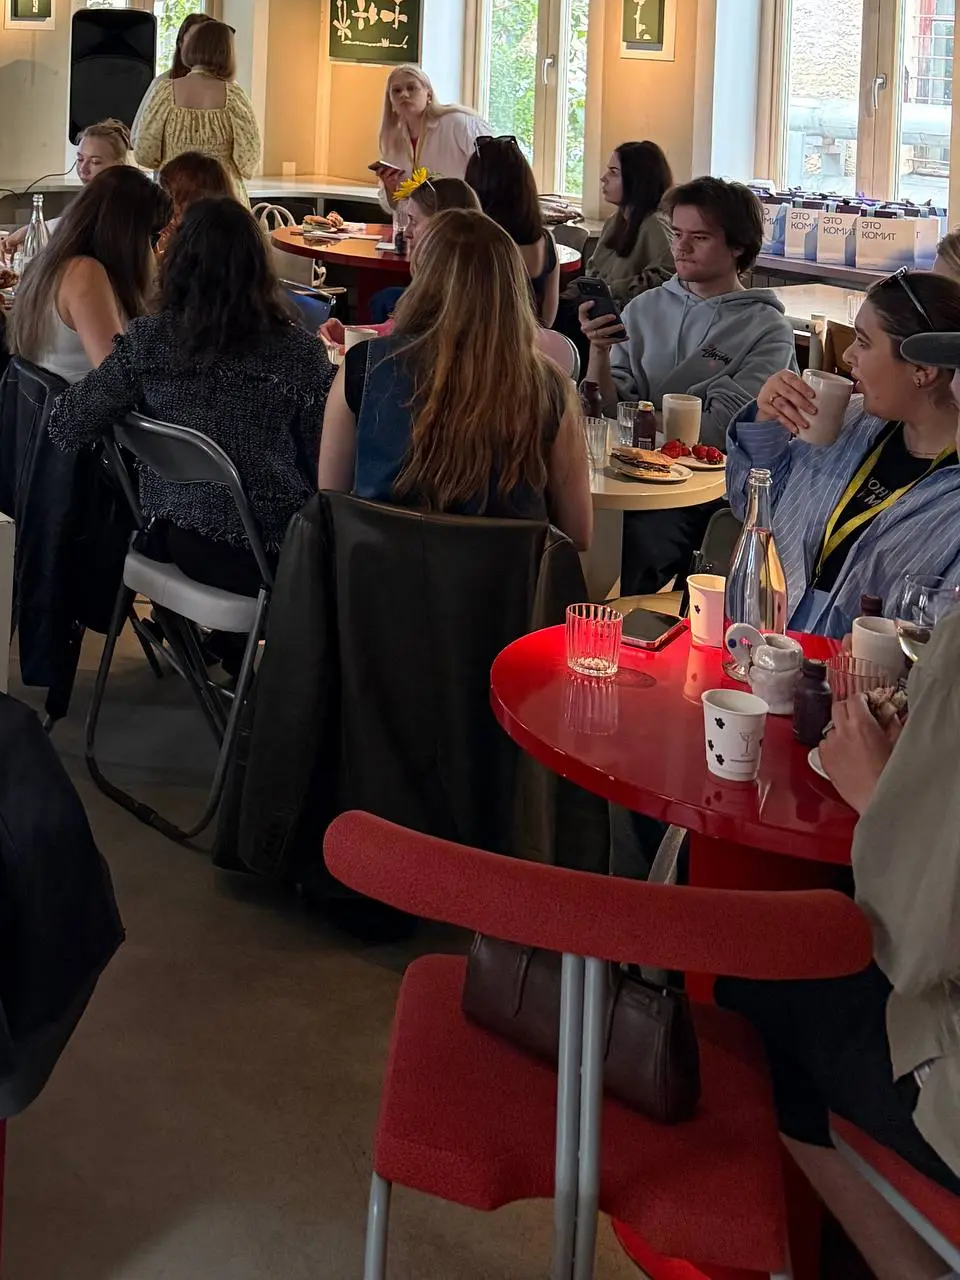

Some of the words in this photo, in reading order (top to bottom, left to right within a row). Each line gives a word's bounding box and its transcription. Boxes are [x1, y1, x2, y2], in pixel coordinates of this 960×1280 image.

[790, 212, 810, 221] ЭТО
[823, 216, 843, 225] ЭТО
[790, 222, 818, 232] КОМИ
[861, 221, 882, 230] ЭТО
[861, 231, 897, 241] КОМИТ
